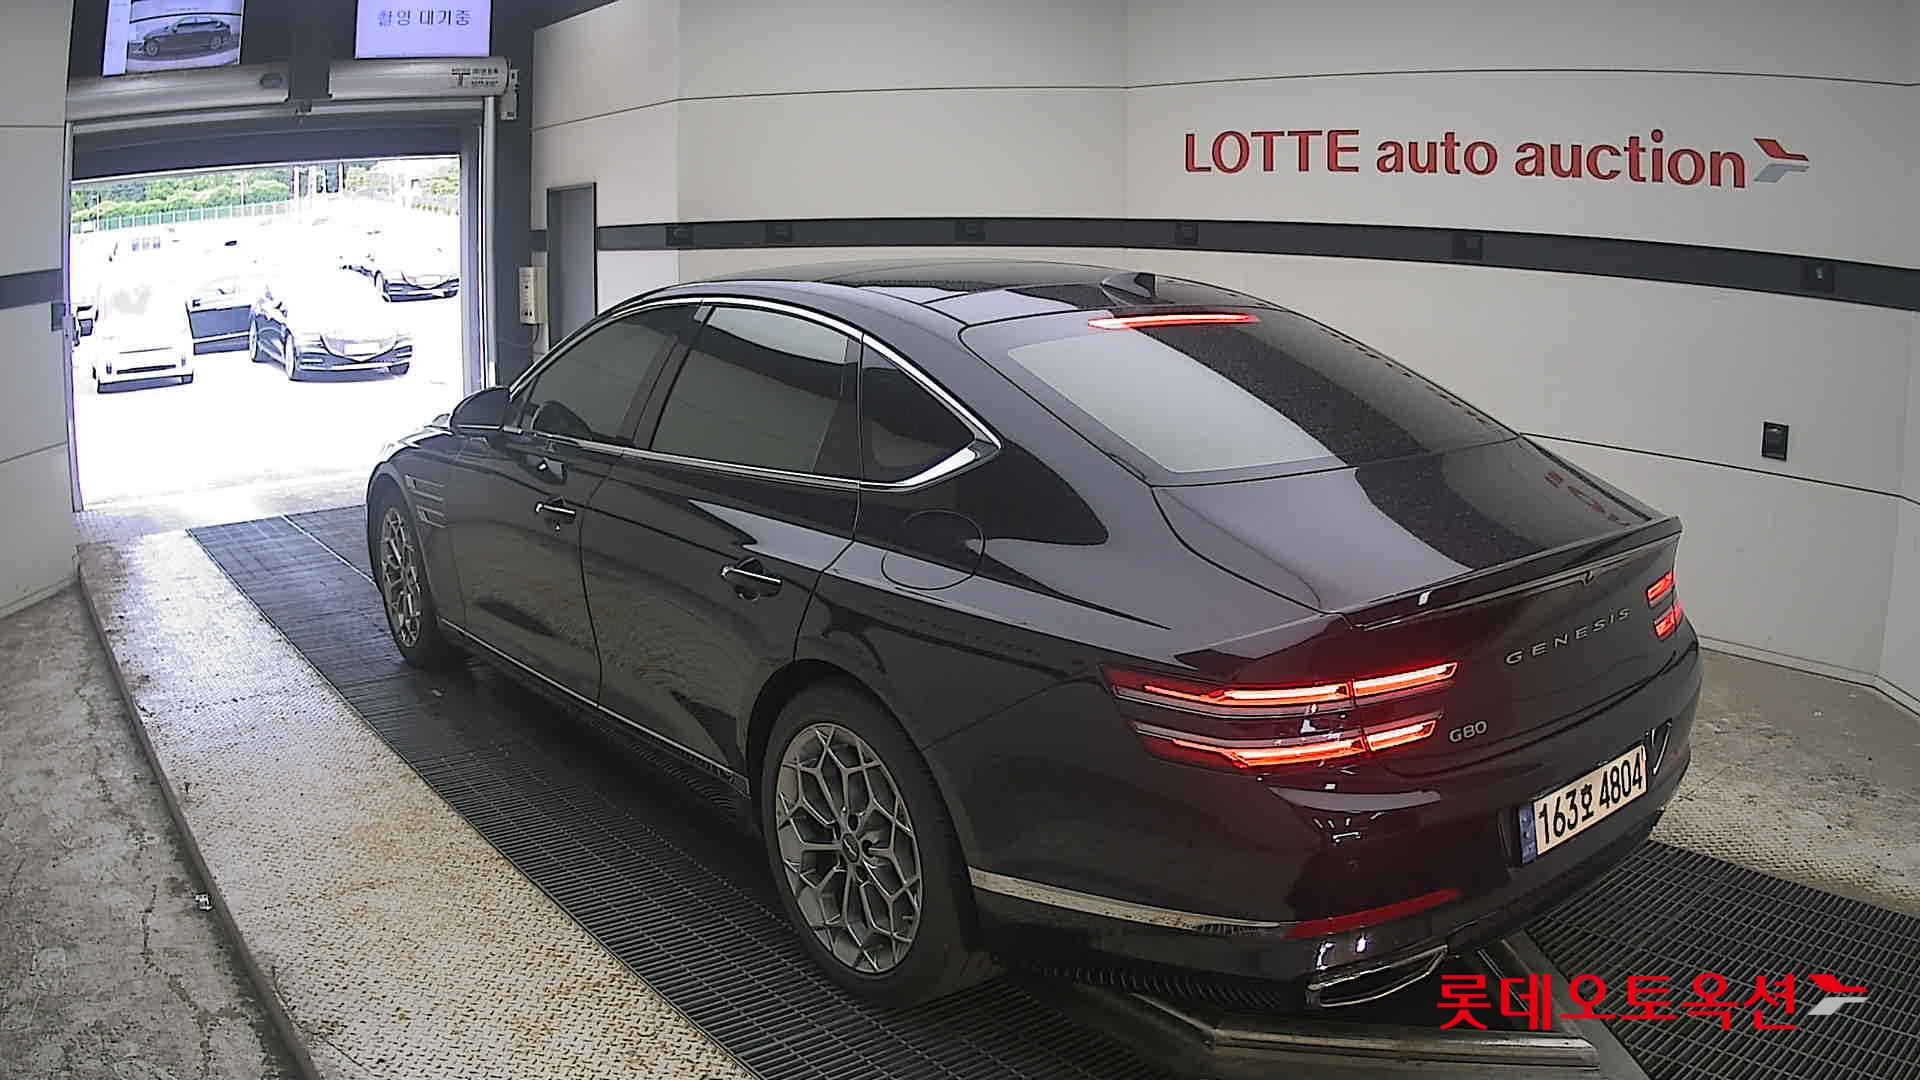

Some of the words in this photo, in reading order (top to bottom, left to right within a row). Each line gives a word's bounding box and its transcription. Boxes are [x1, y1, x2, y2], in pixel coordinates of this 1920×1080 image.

[420, 9, 470, 26] 대기중
[1185, 130, 1360, 174] LOTTE
[1376, 132, 1498, 175] auto
[1515, 129, 1746, 189] auction
[1505, 608, 1631, 665] GENESIS
[1449, 720, 1488, 743] G80
[1538, 783, 1595, 844] 163호
[1600, 752, 1643, 809] 4804
